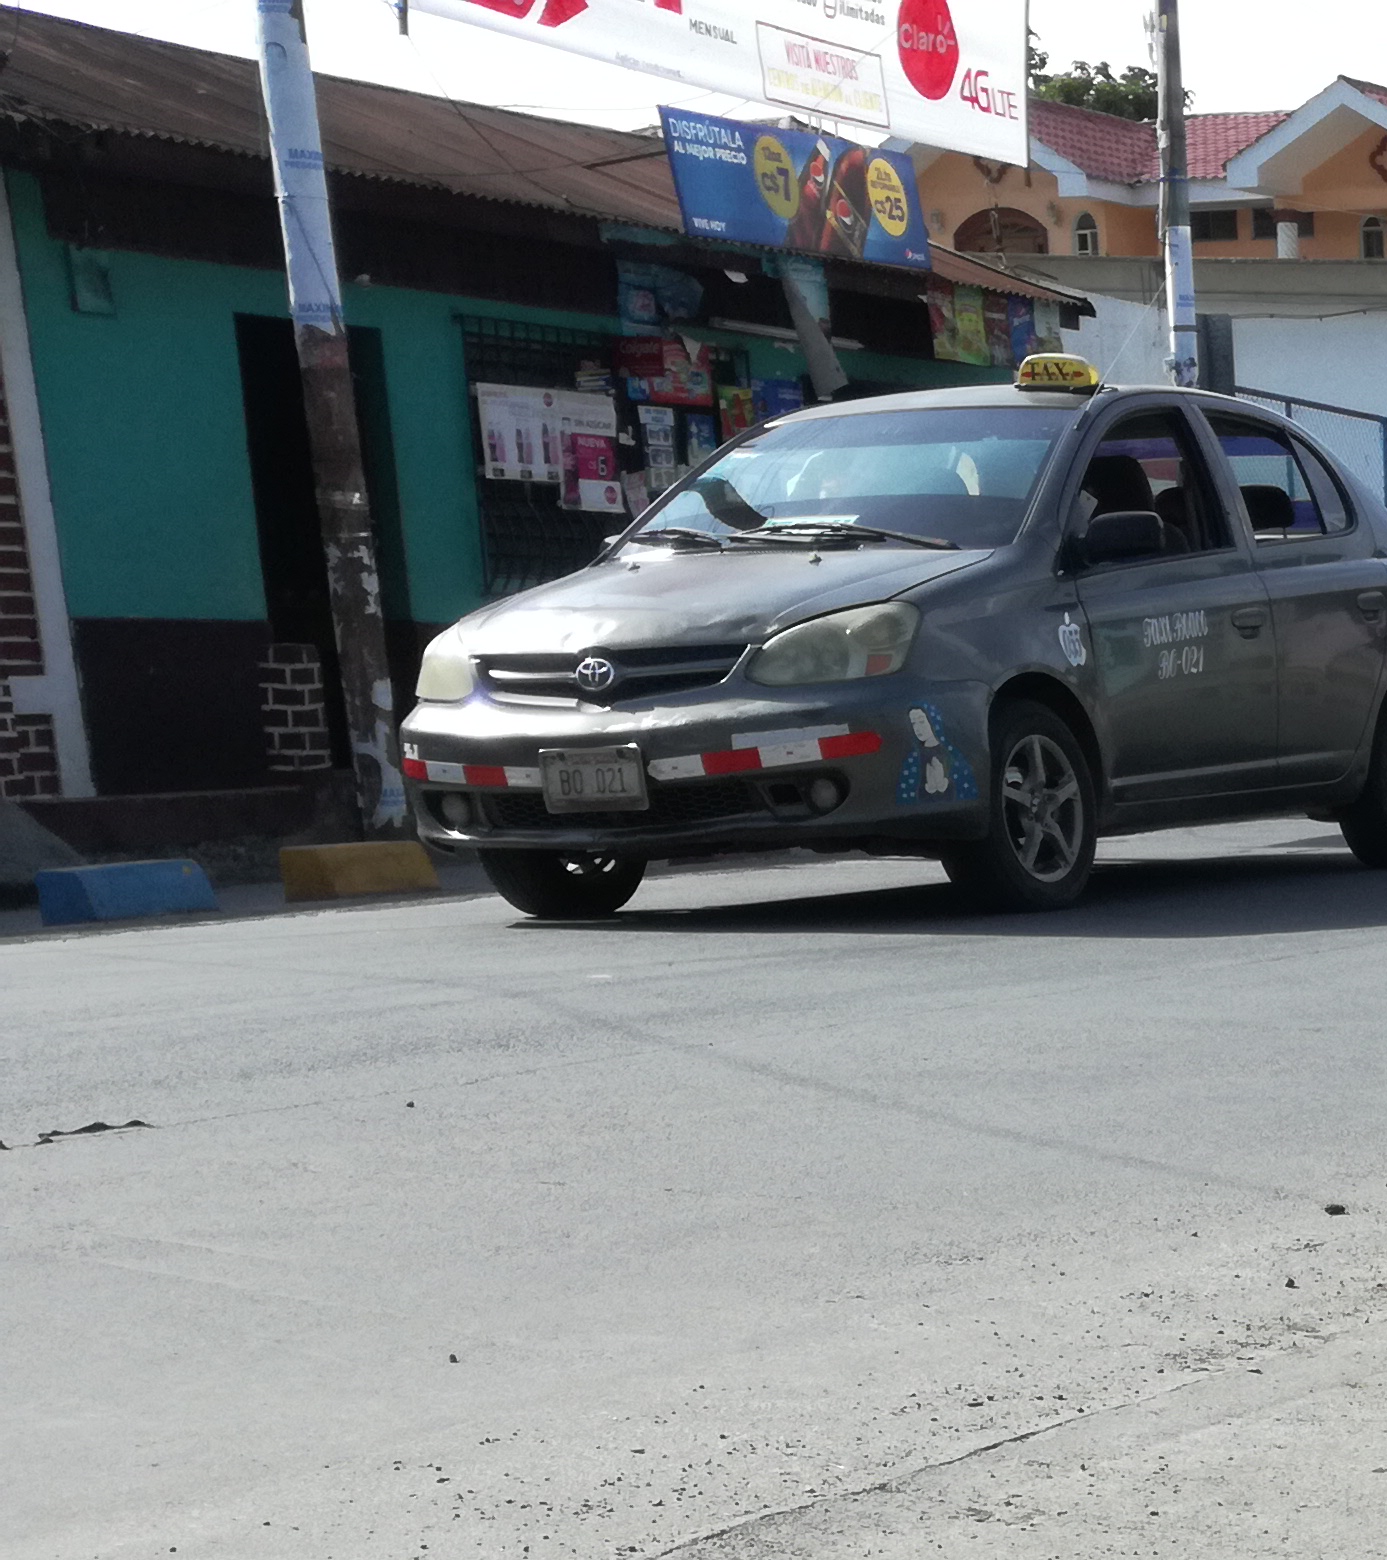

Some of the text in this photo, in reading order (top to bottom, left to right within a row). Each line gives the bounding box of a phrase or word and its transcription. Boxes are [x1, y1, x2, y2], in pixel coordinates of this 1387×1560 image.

[689, 18, 738, 45] MENSUAL
[900, 22, 948, 54] Claro
[813, 48, 860, 82] NUESTROS
[668, 117, 745, 151] DISFRÚTALA
[673, 139, 748, 166] AL MEJOR PRECIO
[692, 216, 727, 233] VIVE HOY
[618, 339, 660, 357] Colgate
[577, 436, 607, 448] NUEVA
[596, 767, 628, 794] 021
